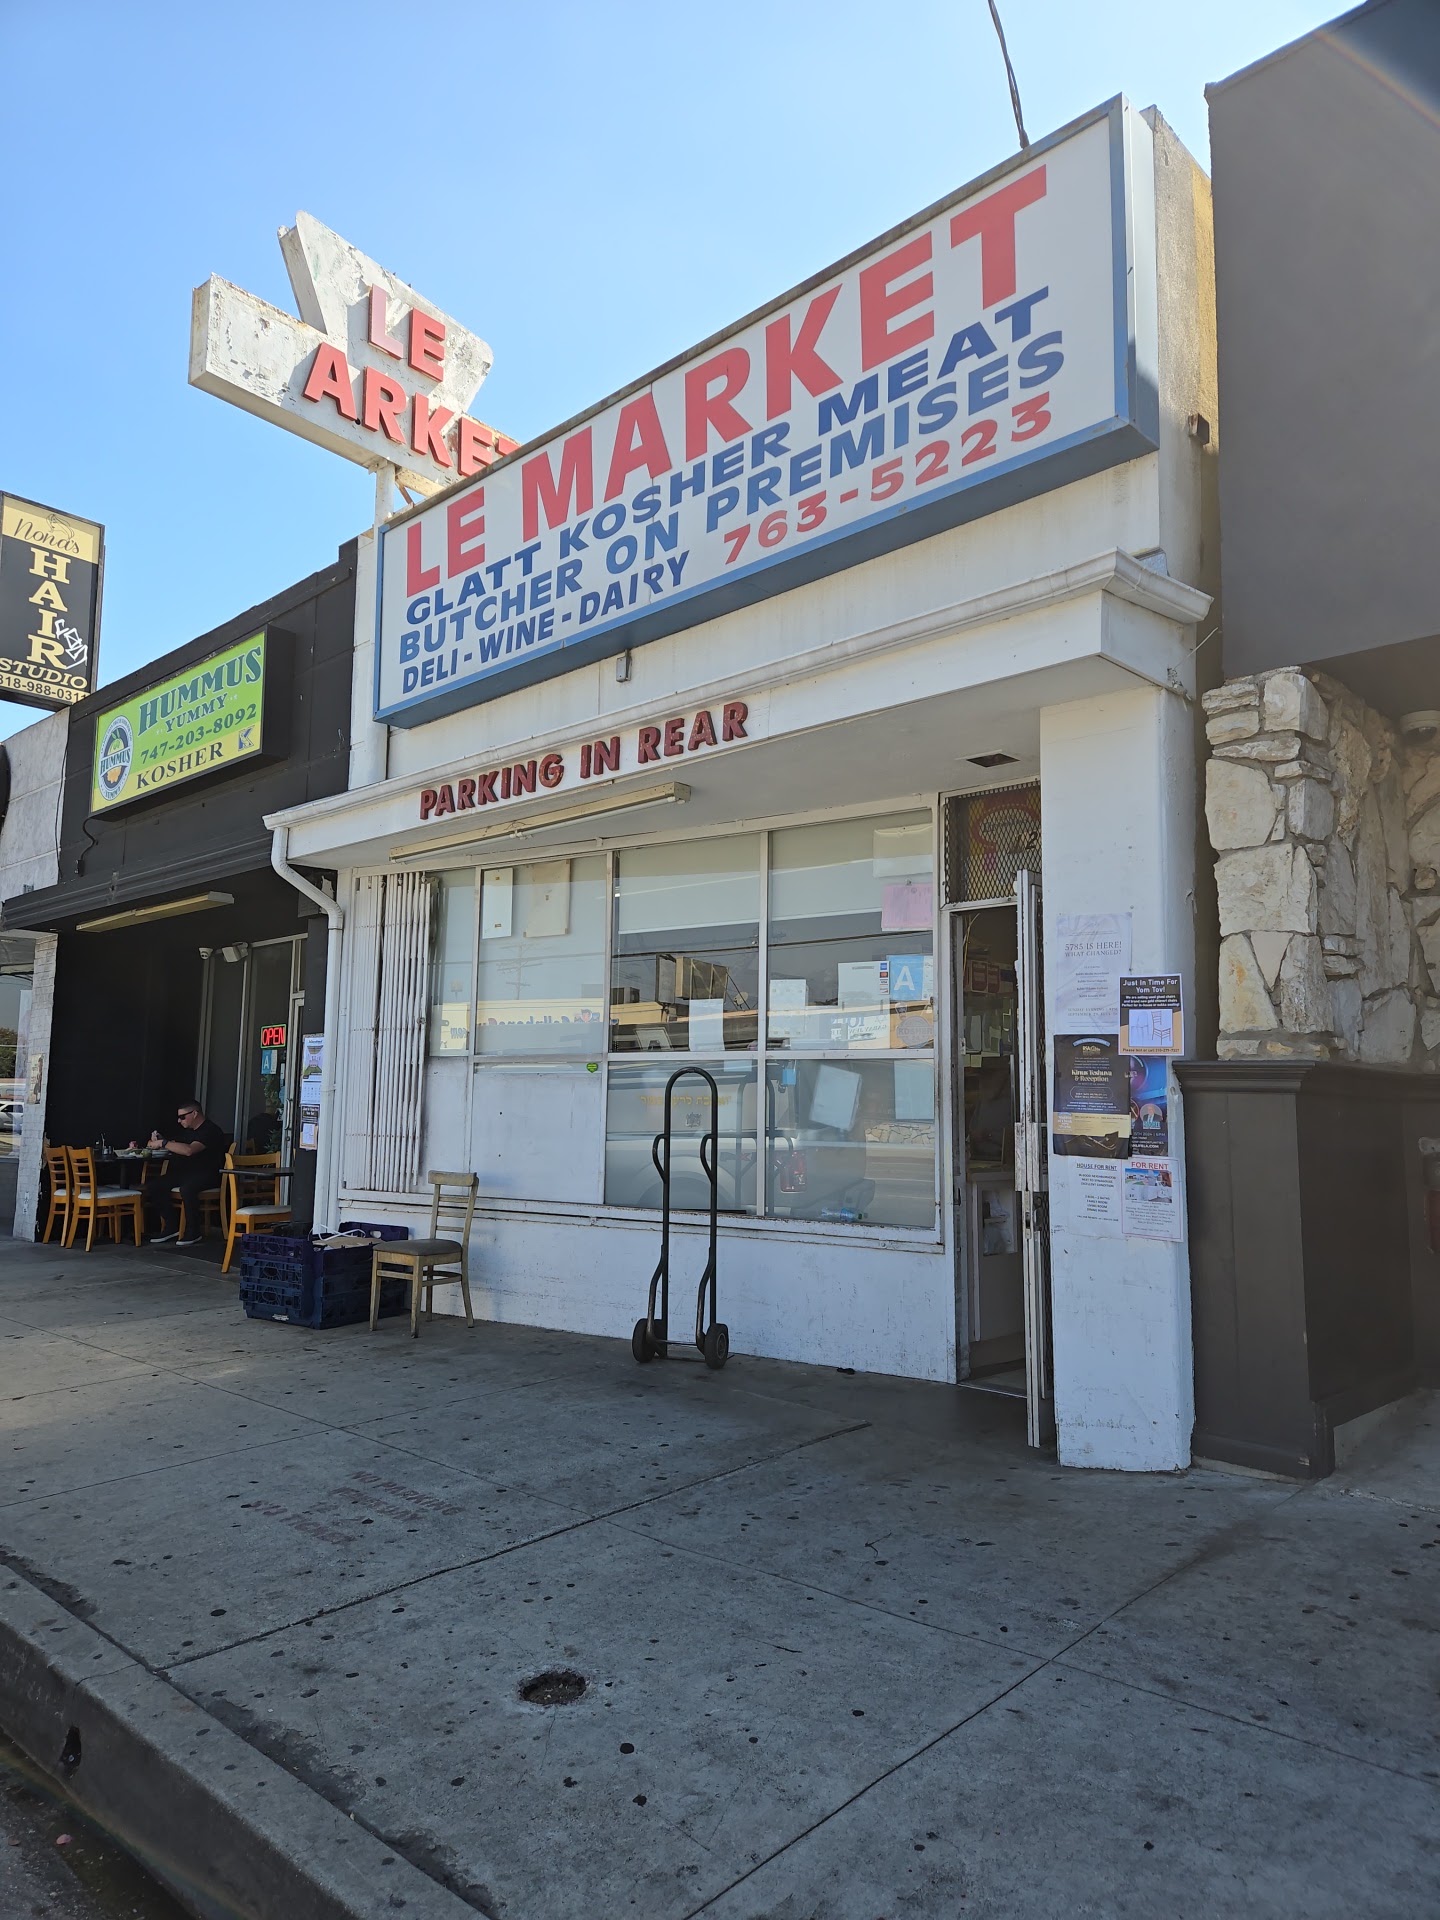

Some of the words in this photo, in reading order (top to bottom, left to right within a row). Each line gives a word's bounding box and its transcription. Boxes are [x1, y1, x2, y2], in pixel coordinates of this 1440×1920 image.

[368, 283, 446, 383] LE
[406, 487, 487, 598] LE
[521, 164, 1047, 542] MARKET
[405, 541, 543, 625] GLATT
[559, 422, 791, 556] KOSHER
[818, 286, 1049, 436] MEAT
[723, 391, 1052, 565] 763-5223
[399, 558, 583, 665] BUTCHER
[606, 515, 679, 579] ON
[705, 331, 1065, 534] PREMISES
[14, 518, 79, 554] Nona's
[26, 547, 71, 670] HAIR
[0, 657, 87, 689] STUDIO
[137, 646, 262, 737] HUMMUS
[141, 703, 257, 765] 747-203-8092
[165, 692, 228, 733] YUMMY
[100, 748, 130, 776] HUMMUS
[137, 741, 224, 790] KOSHER
[420, 753, 564, 820] PARKING
[580, 736, 619, 779] IN
[638, 701, 748, 764] REAR
[1065, 943, 1084, 951] 5785
[1086, 942, 1094, 950] IS
[1096, 941, 1122, 950] HERE!
[894, 965, 915, 991] A
[262, 1027, 285, 1046] OPEN
[263, 1055, 269, 1069] A
[1148, 1162, 1169, 1170] RENT
[346, 1470, 382, 1484] NO
[370, 1481, 467, 1516] PARKING
